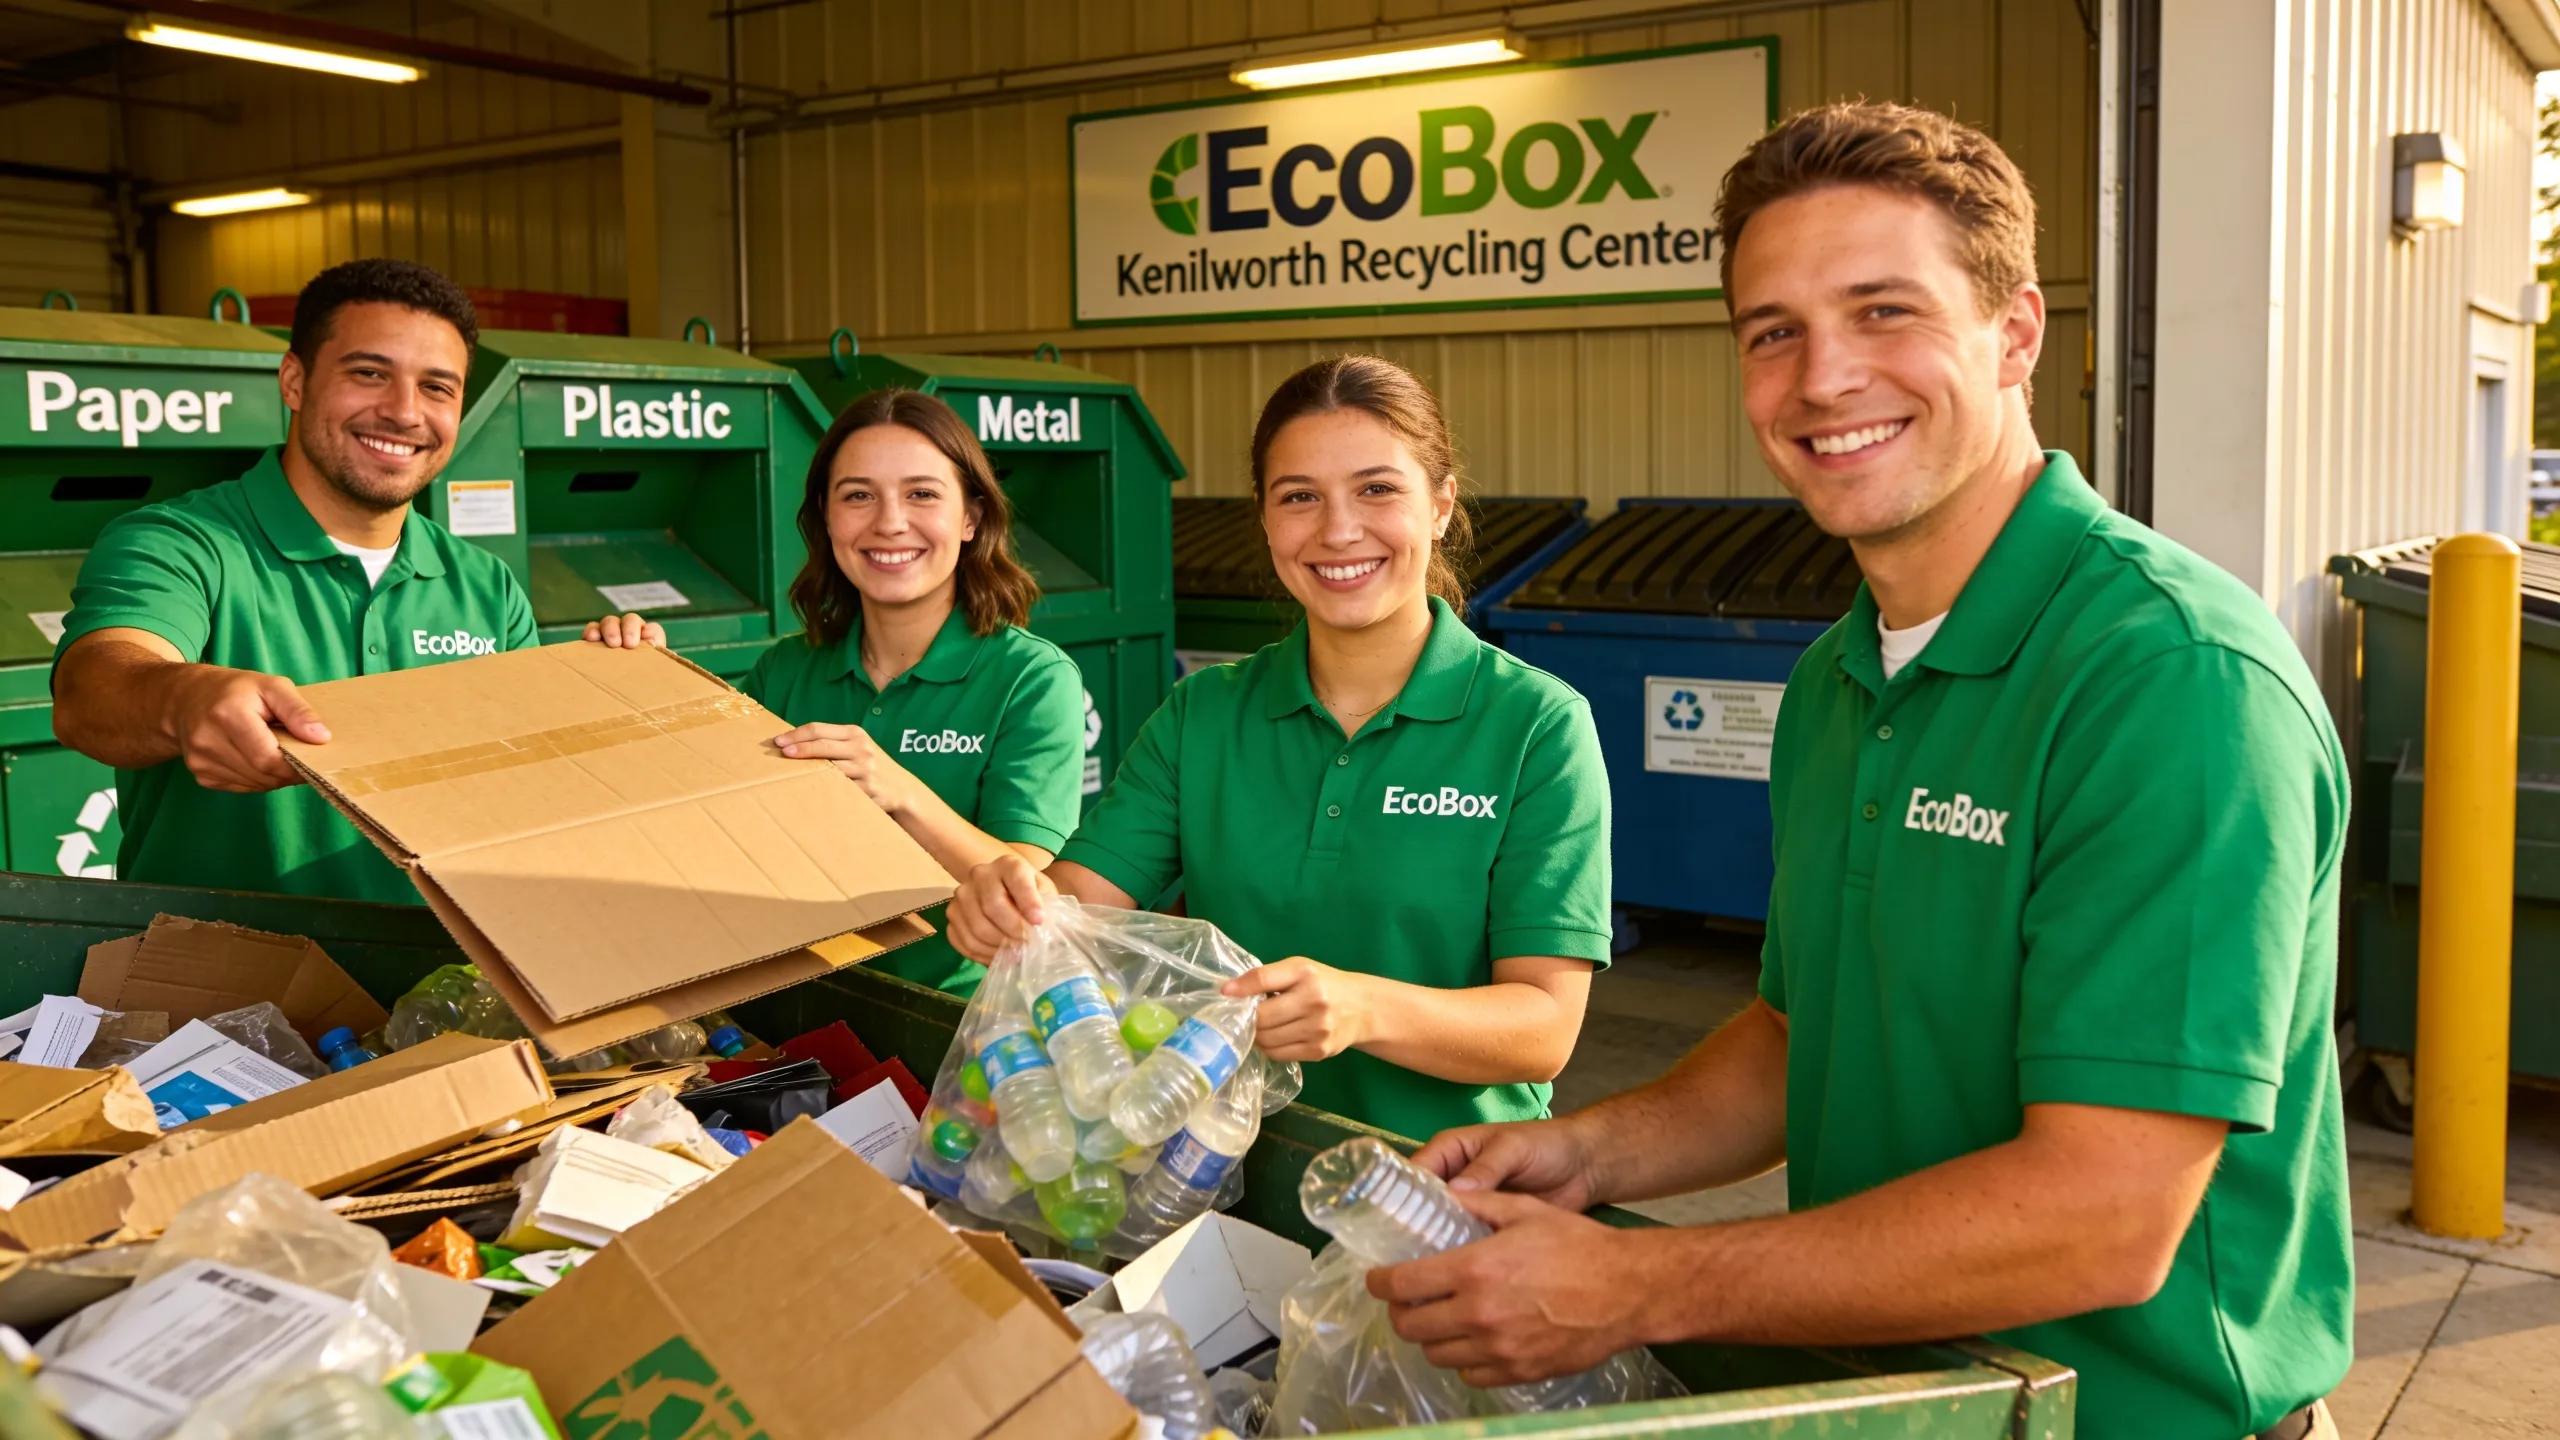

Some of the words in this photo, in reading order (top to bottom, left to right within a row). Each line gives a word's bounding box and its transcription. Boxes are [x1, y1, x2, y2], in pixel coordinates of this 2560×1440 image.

[1207, 105, 1660, 232] EcoBox
[1117, 241, 1326, 296] Kenilworth
[1341, 229, 1545, 290] Recycling
[1560, 221, 1720, 270] Center
[27, 370, 233, 448] Paper
[563, 384, 732, 439] Plastic
[978, 395, 1081, 442] Metal
[412, 629, 497, 656] EcoBox
[899, 729, 986, 754] EcoBox
[1382, 785, 1498, 819] EcoBox
[1904, 787, 2010, 846] EcoBox
